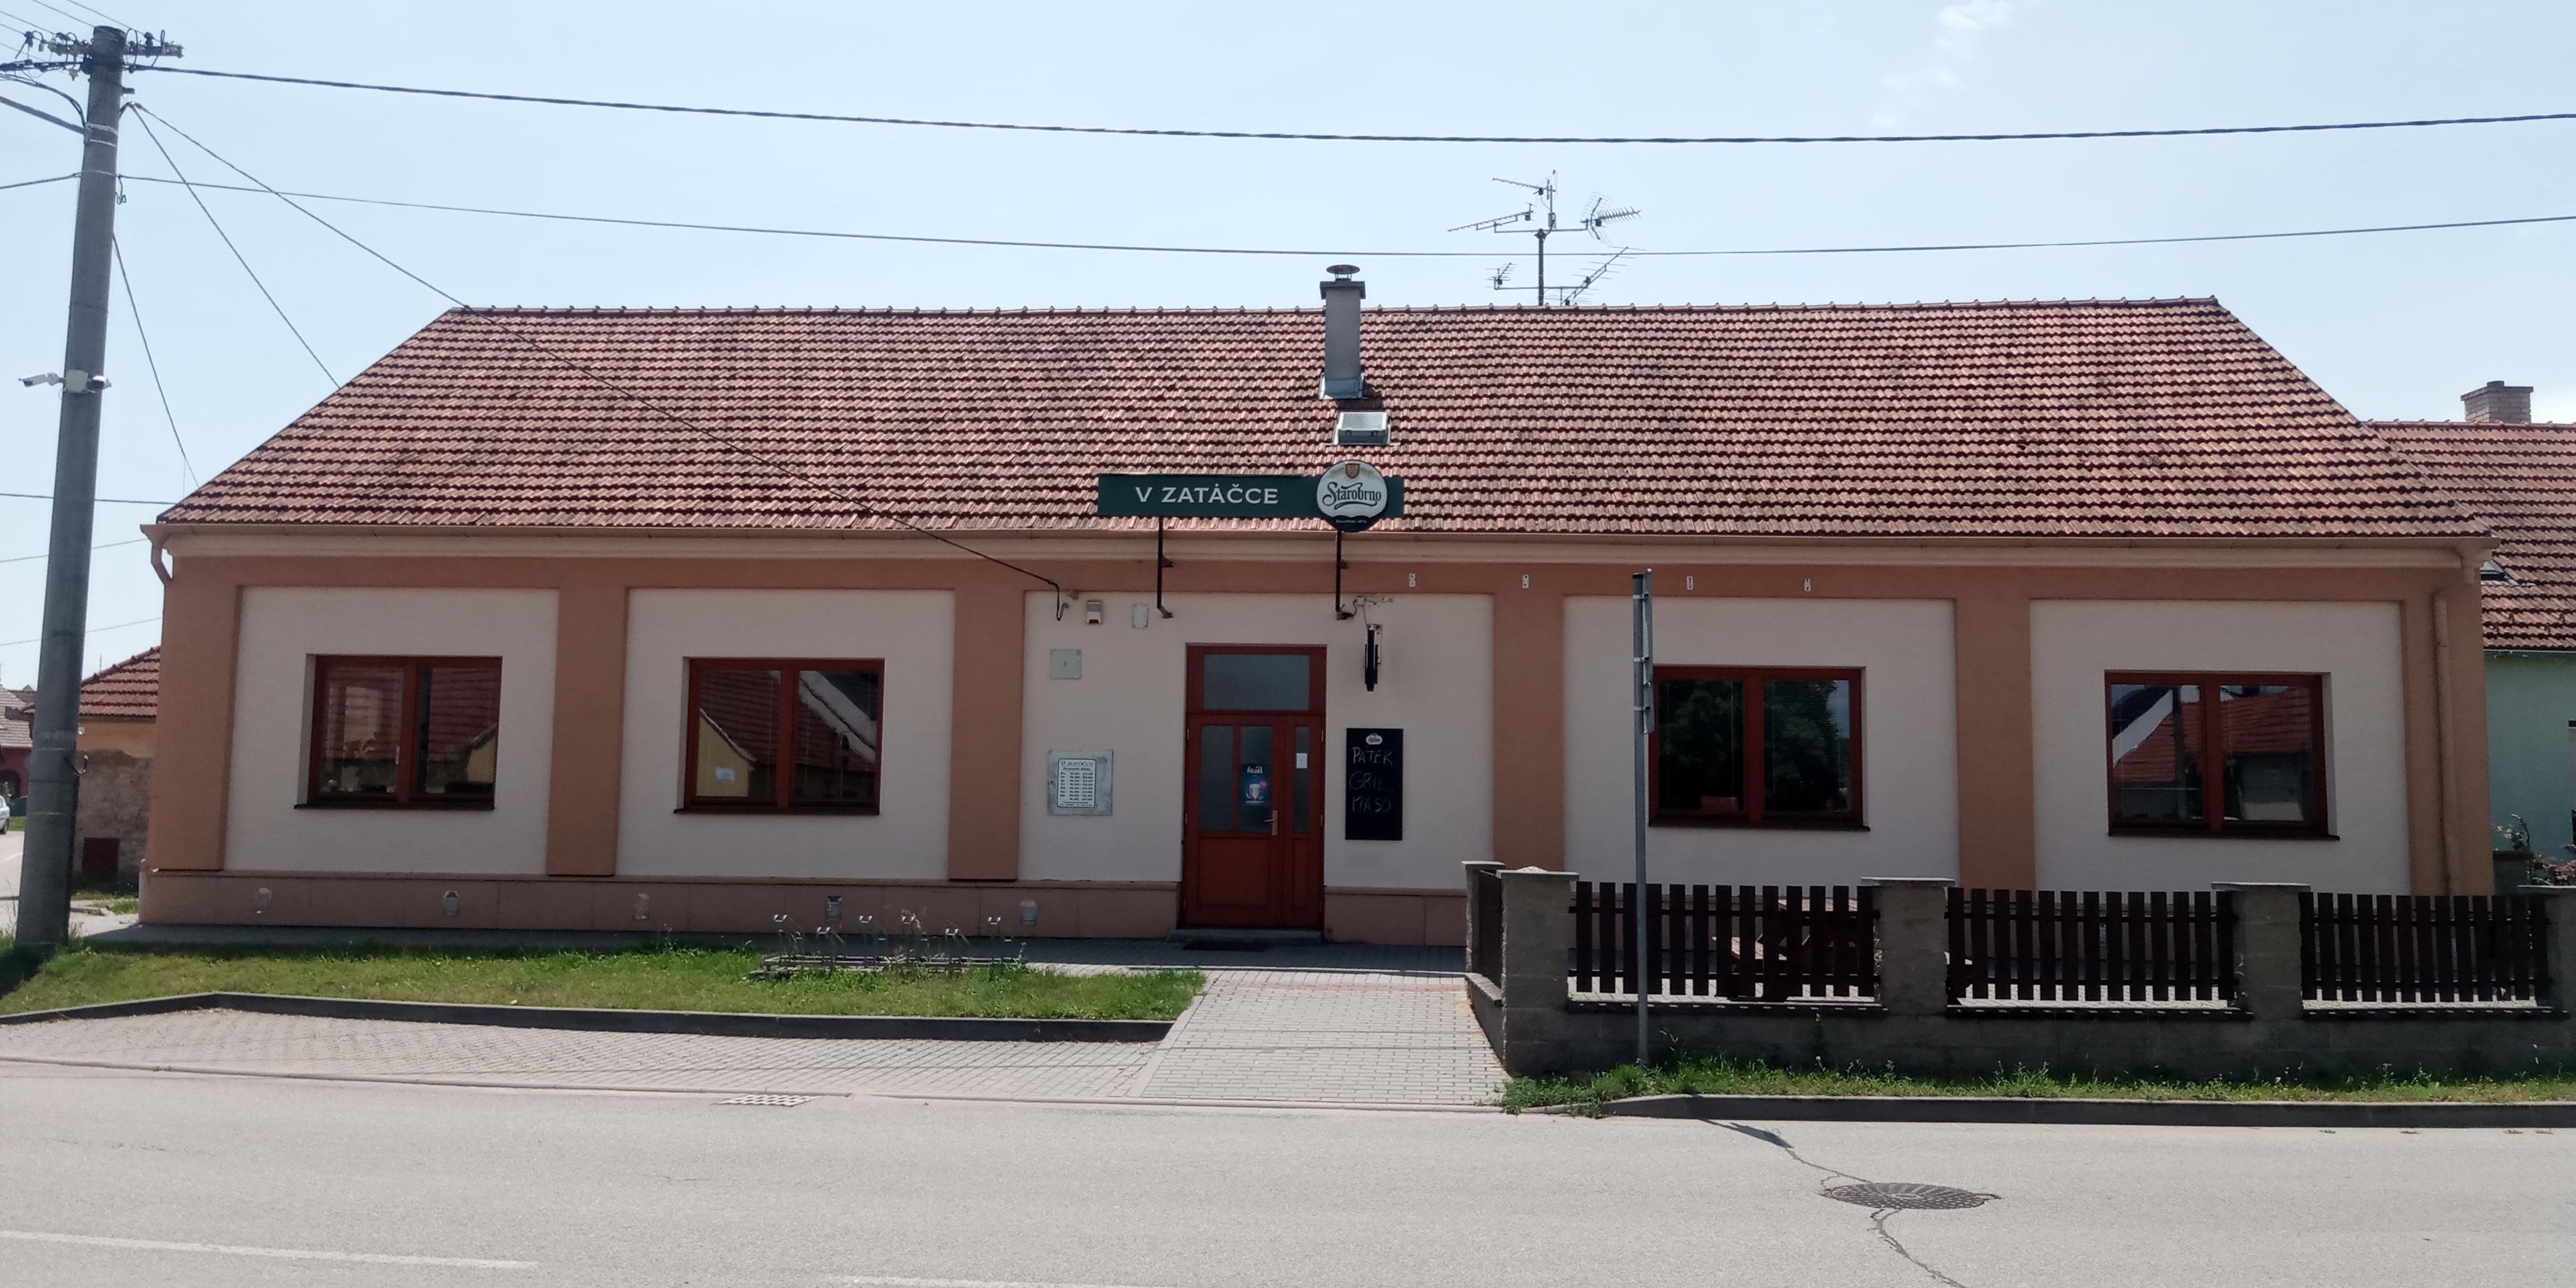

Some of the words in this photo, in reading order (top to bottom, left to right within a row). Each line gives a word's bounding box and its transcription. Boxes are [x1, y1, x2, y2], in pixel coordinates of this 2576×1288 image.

[1135, 486, 1153, 502] V
[1161, 483, 1279, 504] ZATÁČCE
[1322, 481, 1382, 511] Starobrno
[1352, 795, 1392, 813] MASO
